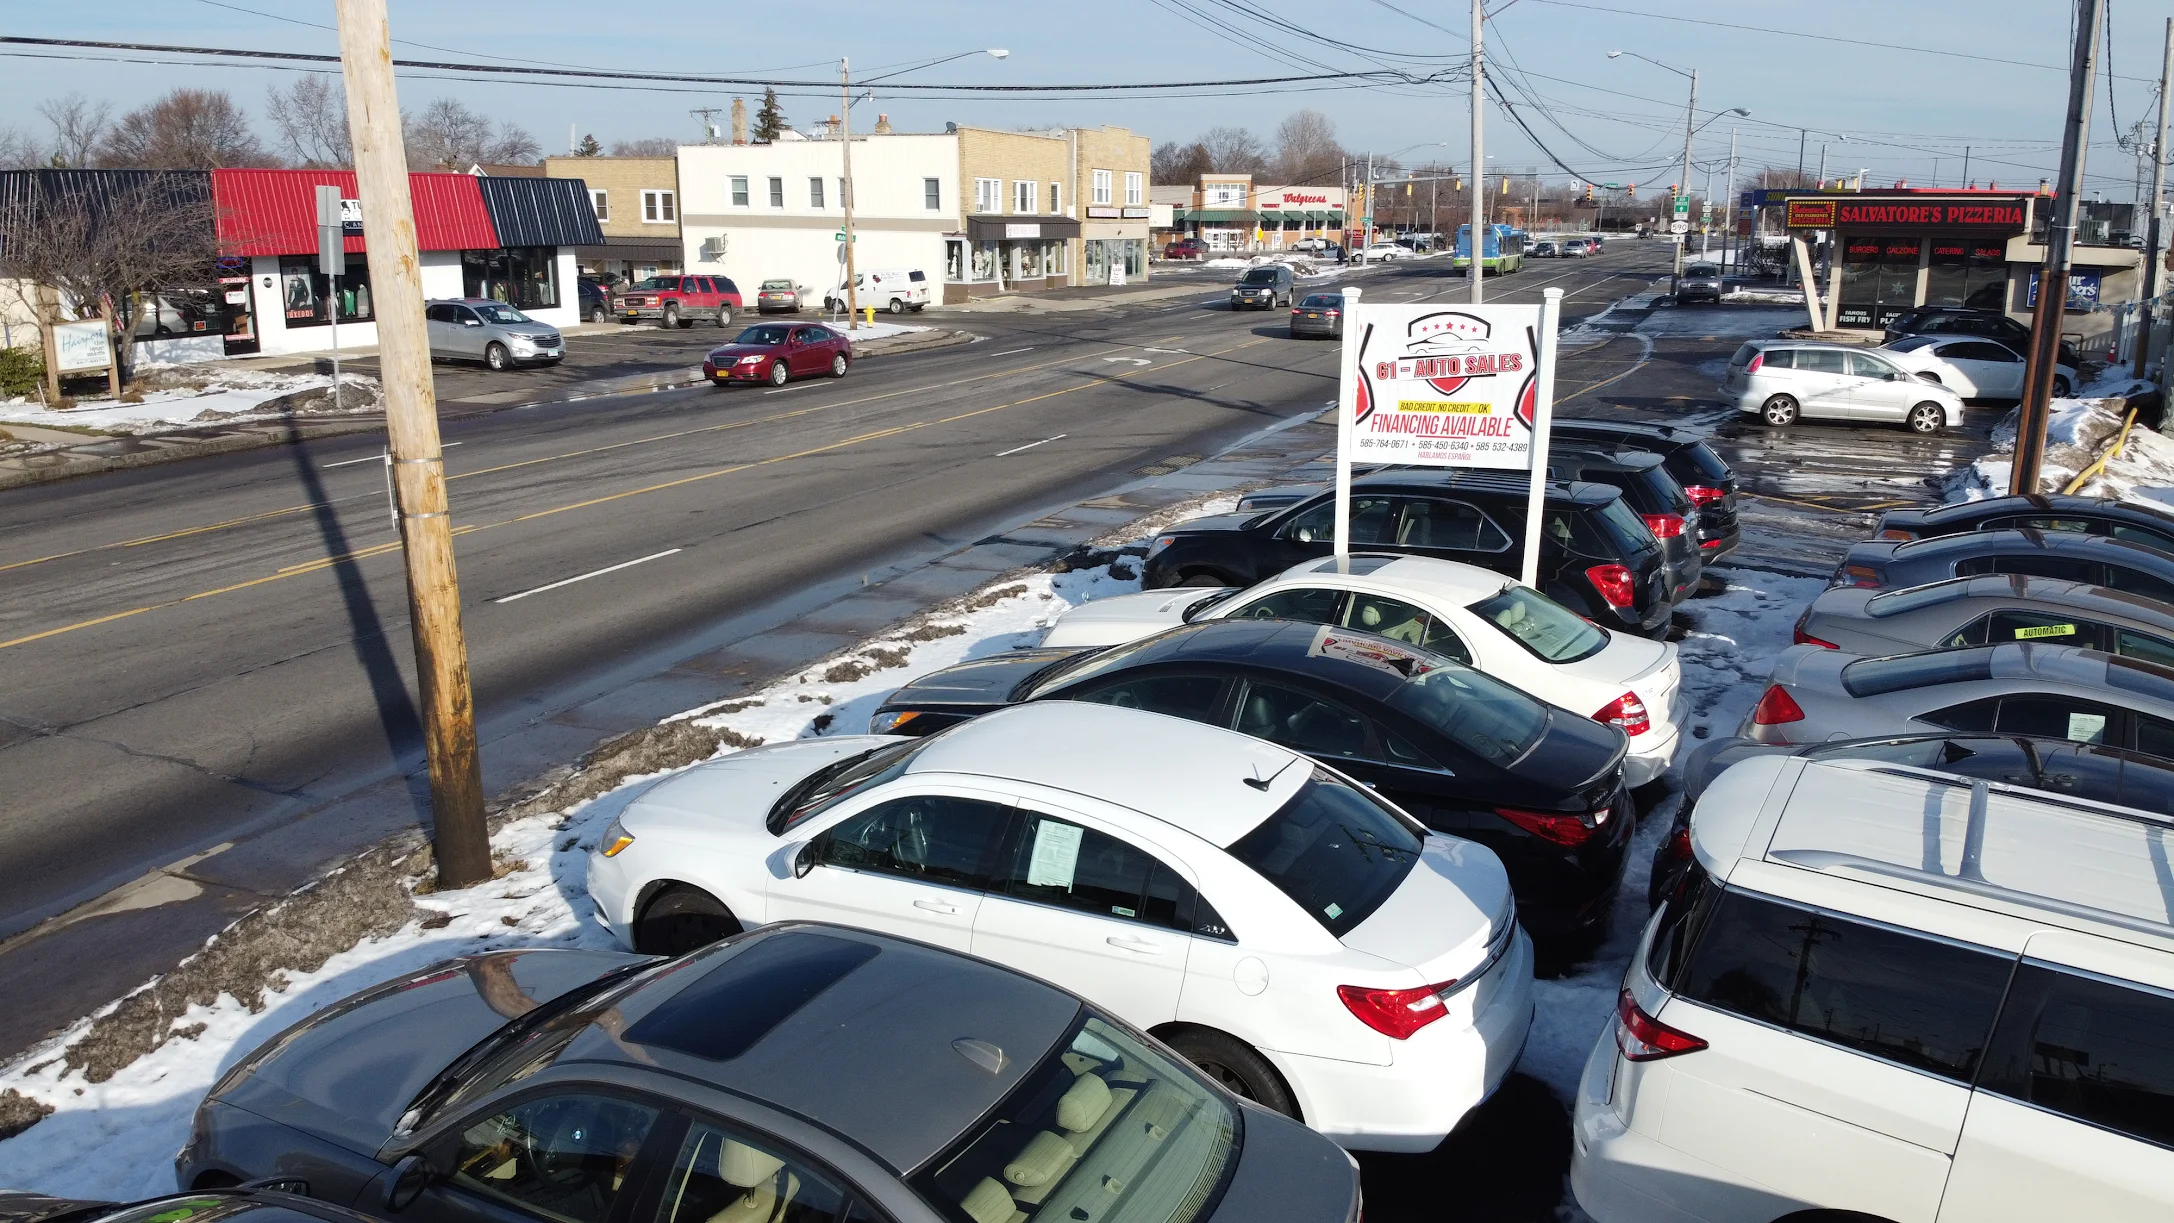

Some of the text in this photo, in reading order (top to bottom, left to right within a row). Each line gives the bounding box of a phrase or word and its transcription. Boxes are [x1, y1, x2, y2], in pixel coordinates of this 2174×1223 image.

[1283, 193, 1327, 206] Walgreens
[1840, 206, 2022, 224] SALVATORE'S PIZZERIA
[1849, 246, 1879, 254] BURGERS
[1886, 246, 1919, 254] CALZONE
[1934, 247, 1964, 255] CATERING
[1376, 361, 1397, 380] G1
[1414, 357, 1460, 378] AUTO
[1466, 353, 1522, 374] SALES
[1400, 402, 1488, 414] BAD CREDIT NO CREDIT OK
[1370, 414, 1514, 437] FINANCING AVAILABLE
[1360, 439, 1528, 452] 585-764-0671 585-450-6340 585 532-4389
[1418, 452, 1472, 460] HABLAMOS ESPAÑOL
[2023, 625, 2066, 637] AUTOMATIC
